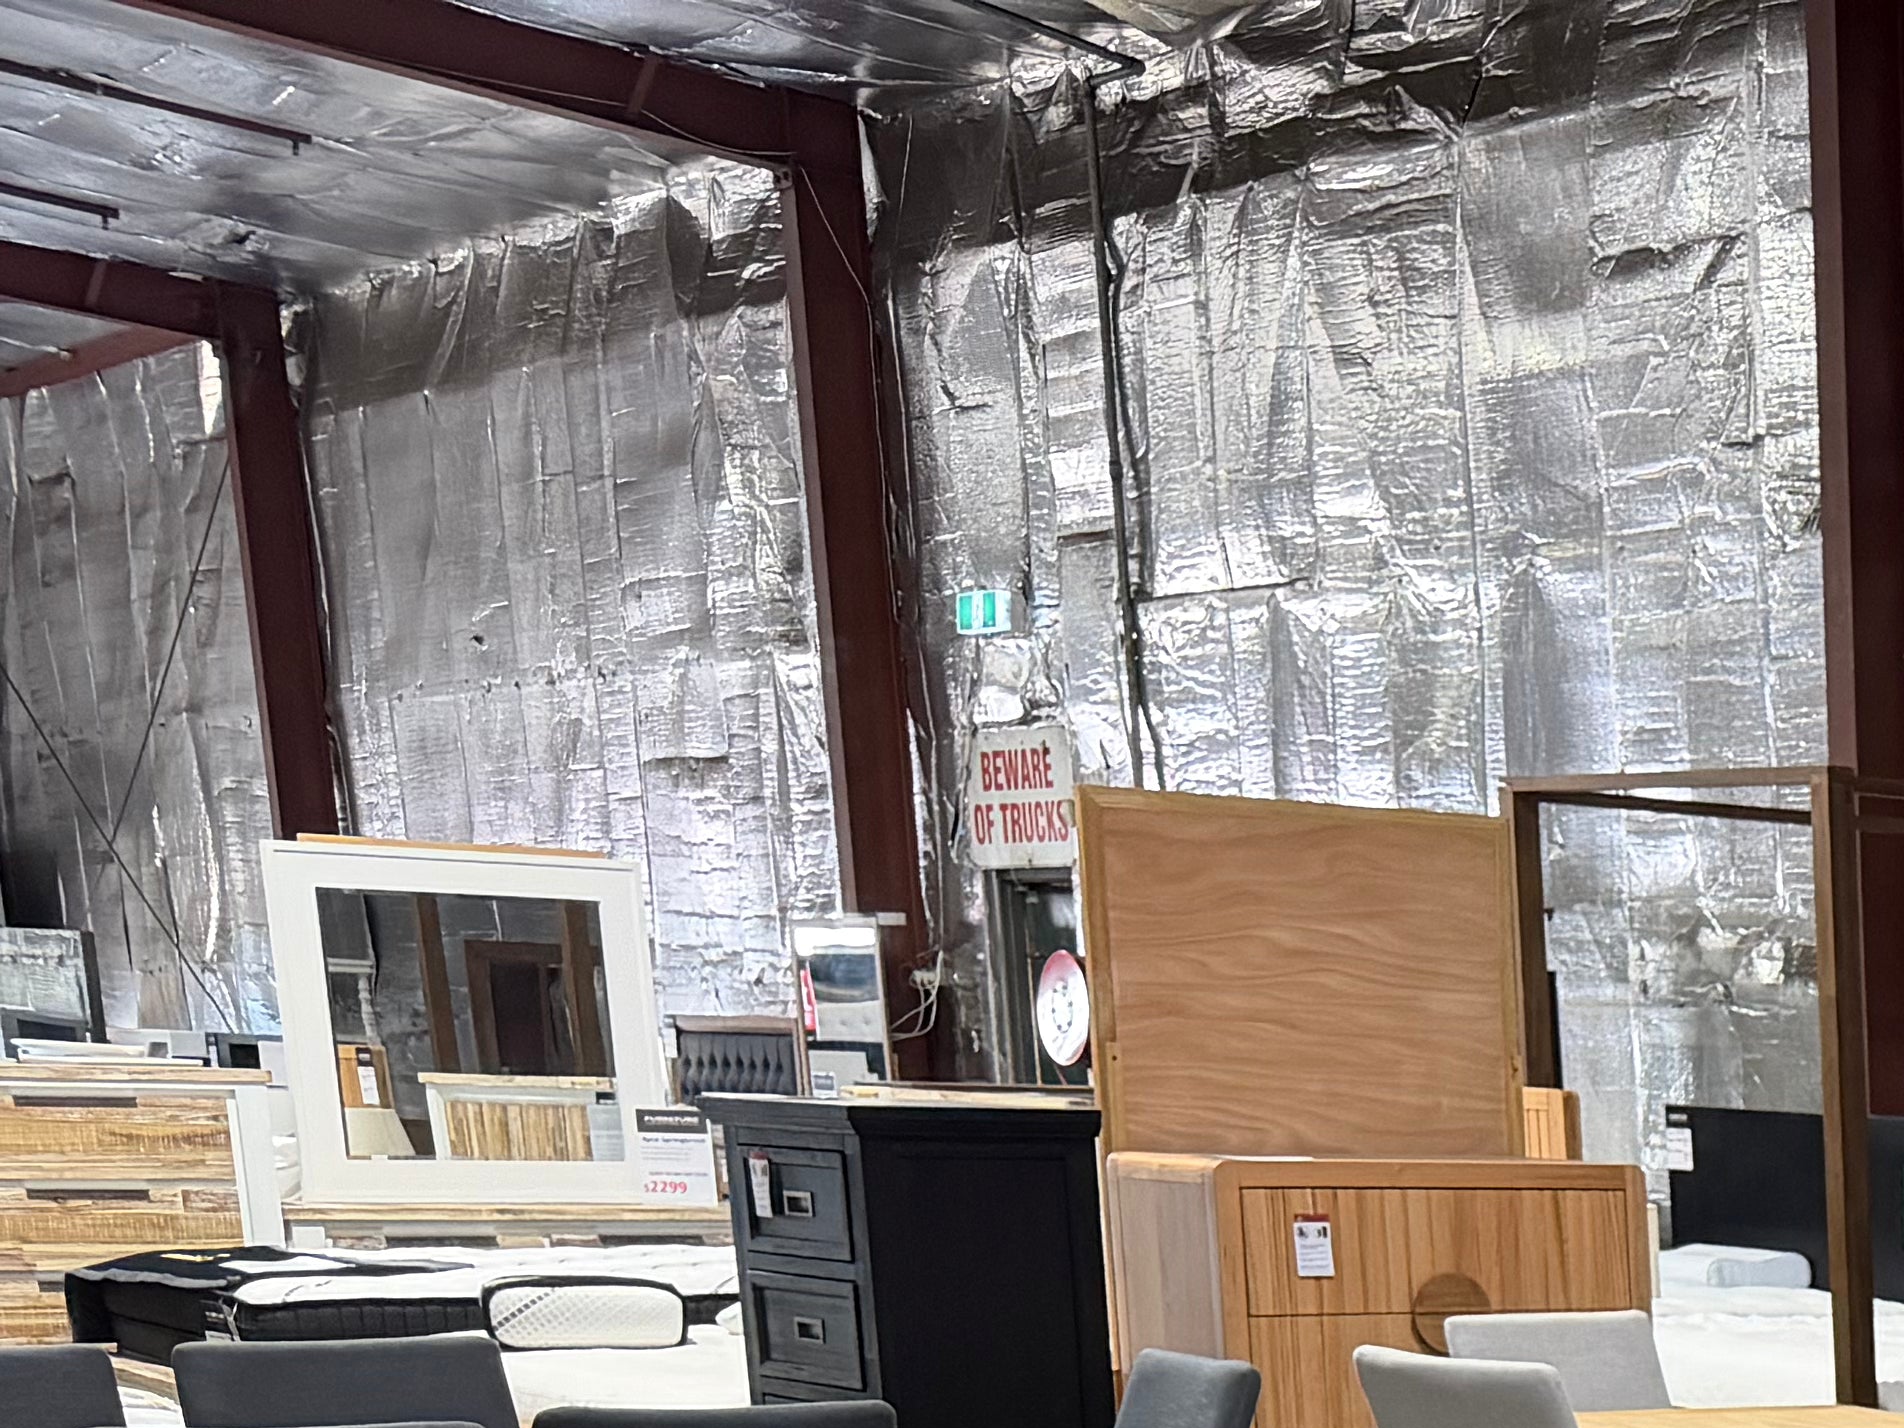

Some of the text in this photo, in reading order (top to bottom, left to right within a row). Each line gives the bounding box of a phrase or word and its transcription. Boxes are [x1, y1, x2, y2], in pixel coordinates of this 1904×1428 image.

[980, 747, 1054, 792] BEWARE
[974, 800, 1069, 845] OF TRUCKS
[643, 1180, 688, 1194] $2299
